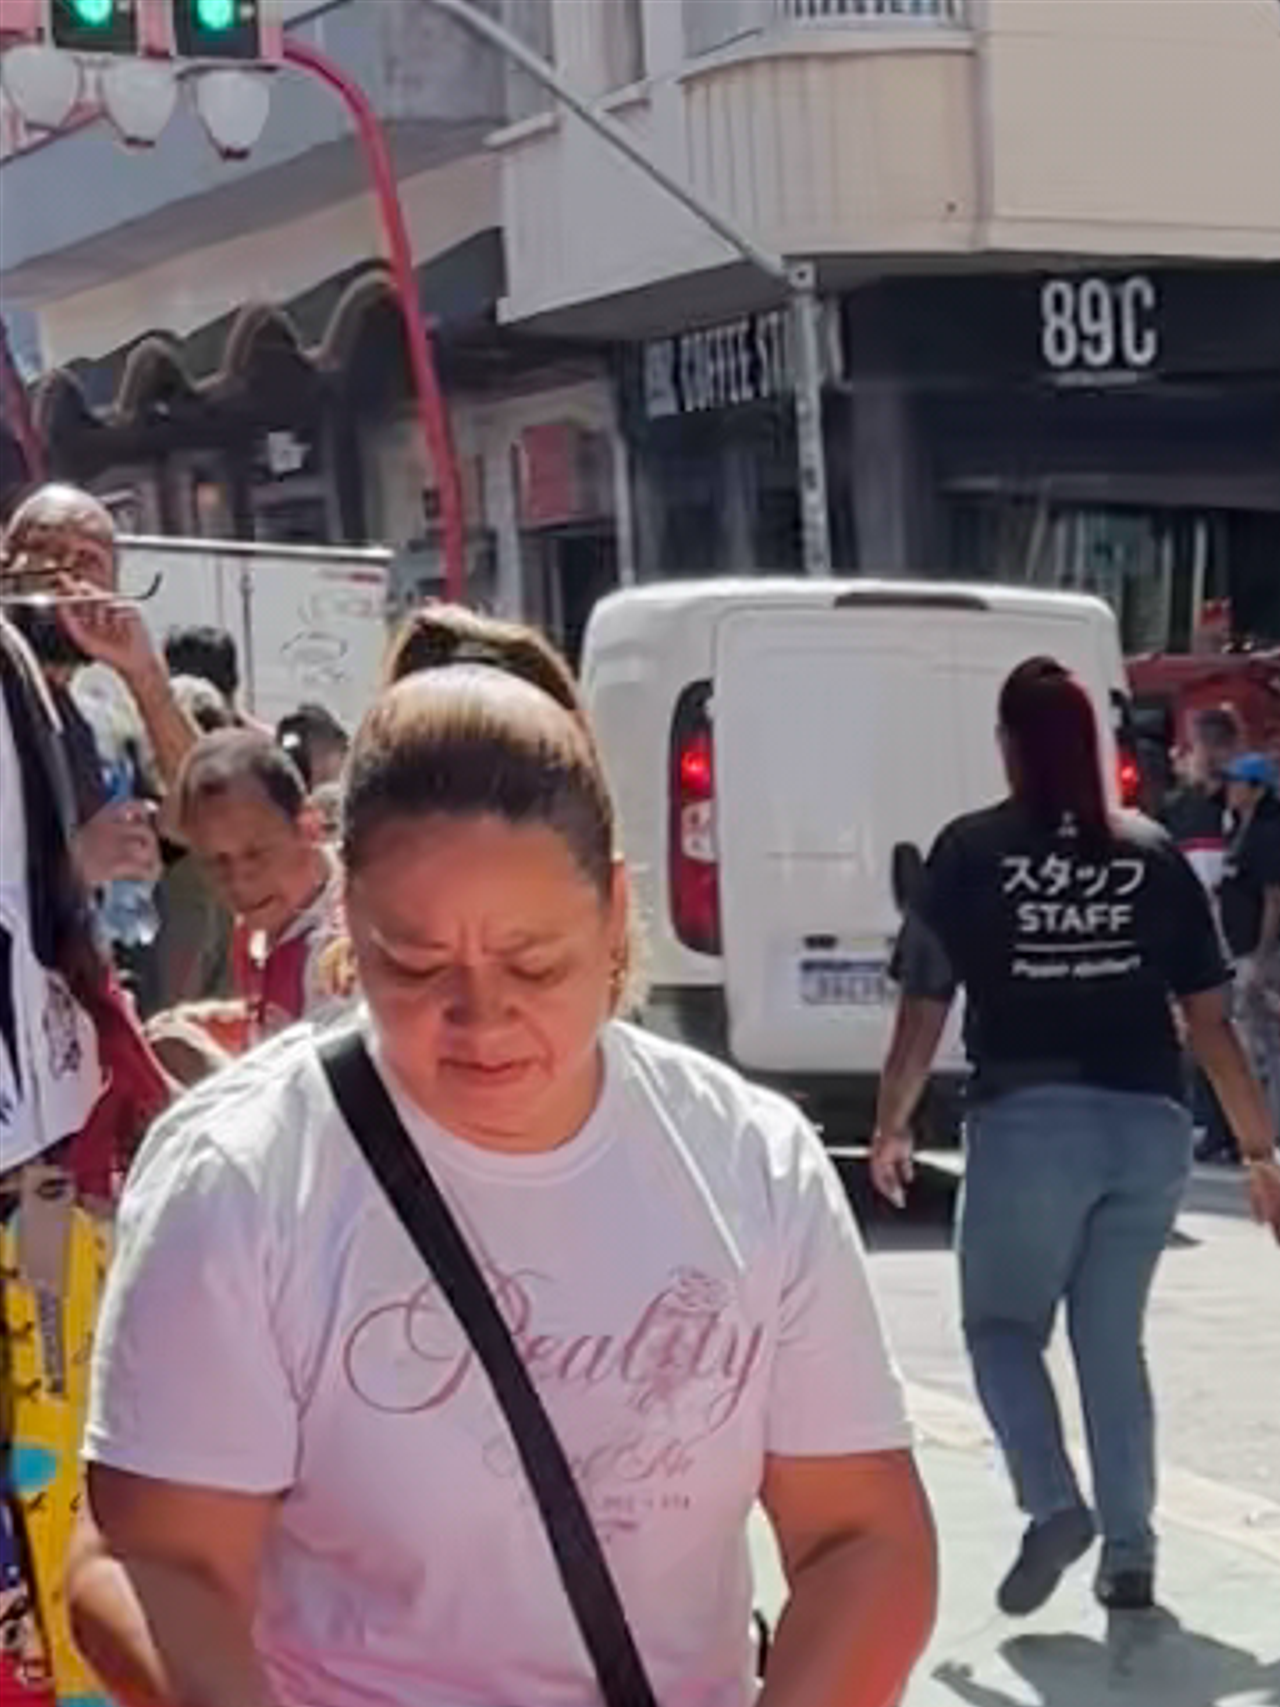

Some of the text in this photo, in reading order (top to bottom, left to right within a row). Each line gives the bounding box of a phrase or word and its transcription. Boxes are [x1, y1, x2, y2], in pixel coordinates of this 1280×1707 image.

[1003, 855, 1145, 897] スタッフ
[1017, 904, 1133, 932] STAFF
